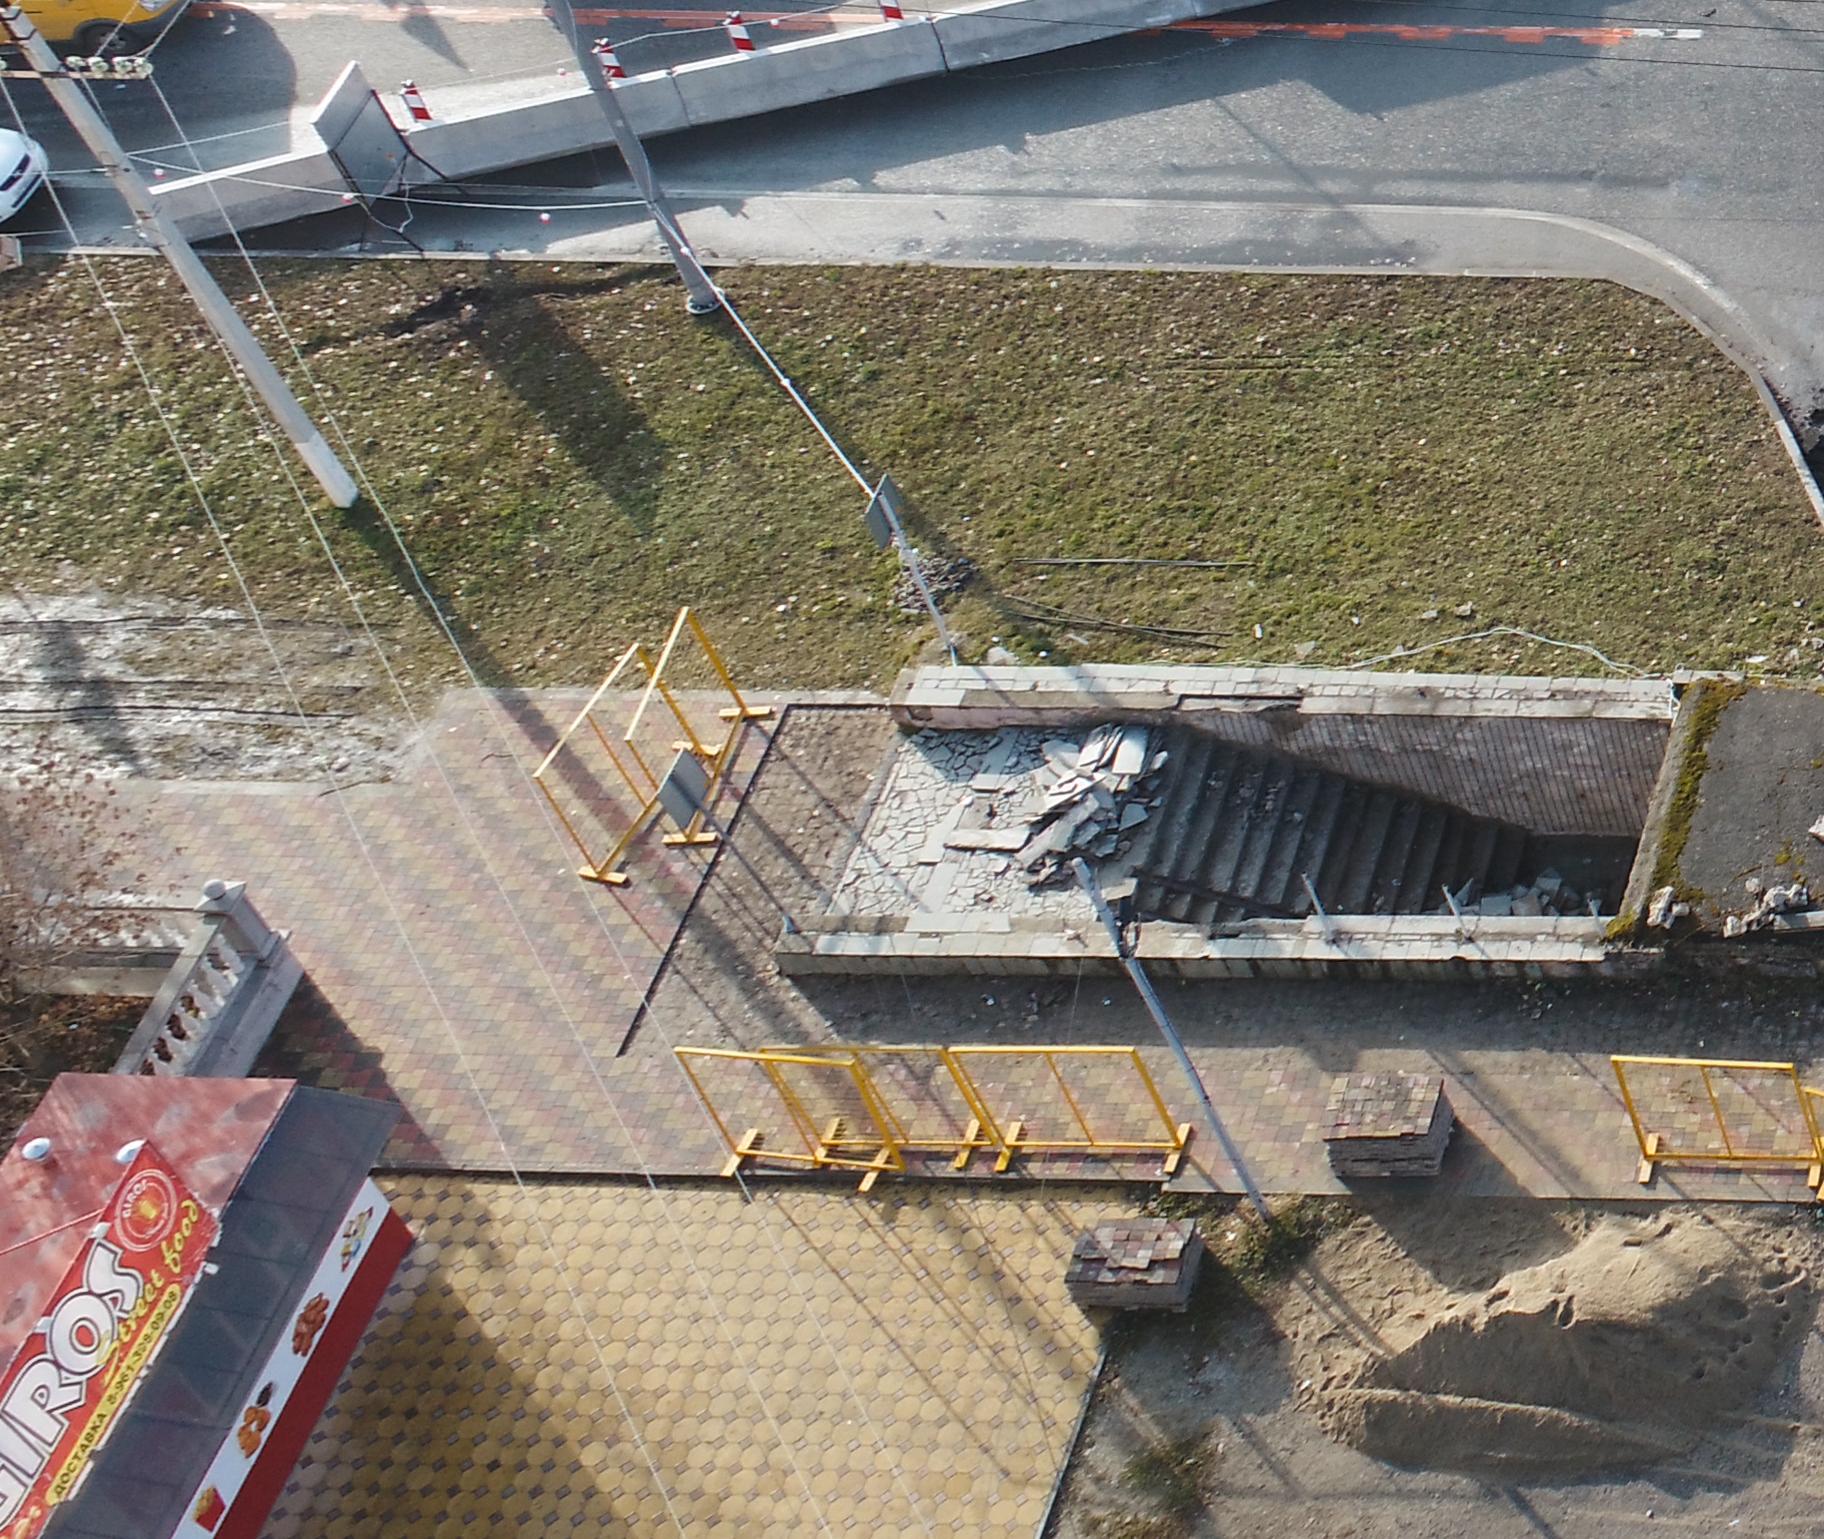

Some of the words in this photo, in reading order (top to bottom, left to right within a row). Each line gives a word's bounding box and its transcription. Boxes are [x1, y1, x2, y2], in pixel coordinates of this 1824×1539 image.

[97, 1267, 164, 1387] Street
[161, 1199, 199, 1274] food
[54, 1412, 107, 1498] ДОСТАВКА
